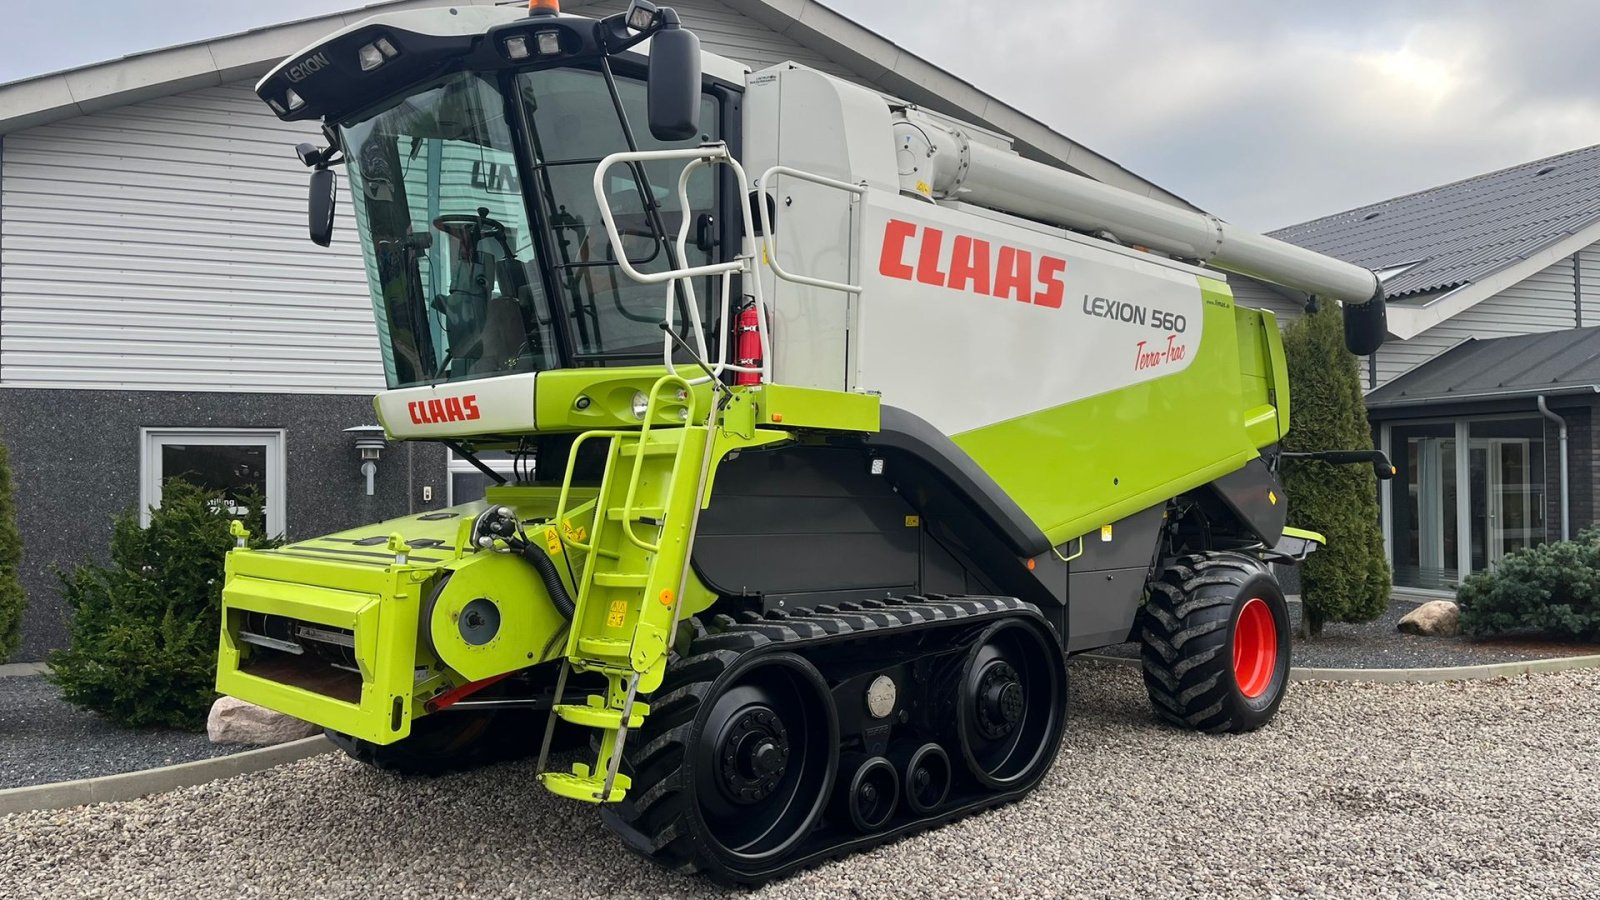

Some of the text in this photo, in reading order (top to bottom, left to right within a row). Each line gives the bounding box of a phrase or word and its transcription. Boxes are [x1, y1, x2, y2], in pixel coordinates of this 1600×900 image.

[284, 51, 330, 83] LEXION
[878, 218, 1067, 310] CLAAS
[1082, 294, 1187, 333] LEXION 560
[1134, 334, 1187, 371] Terra-Trac
[408, 395, 481, 425] CLAAS
